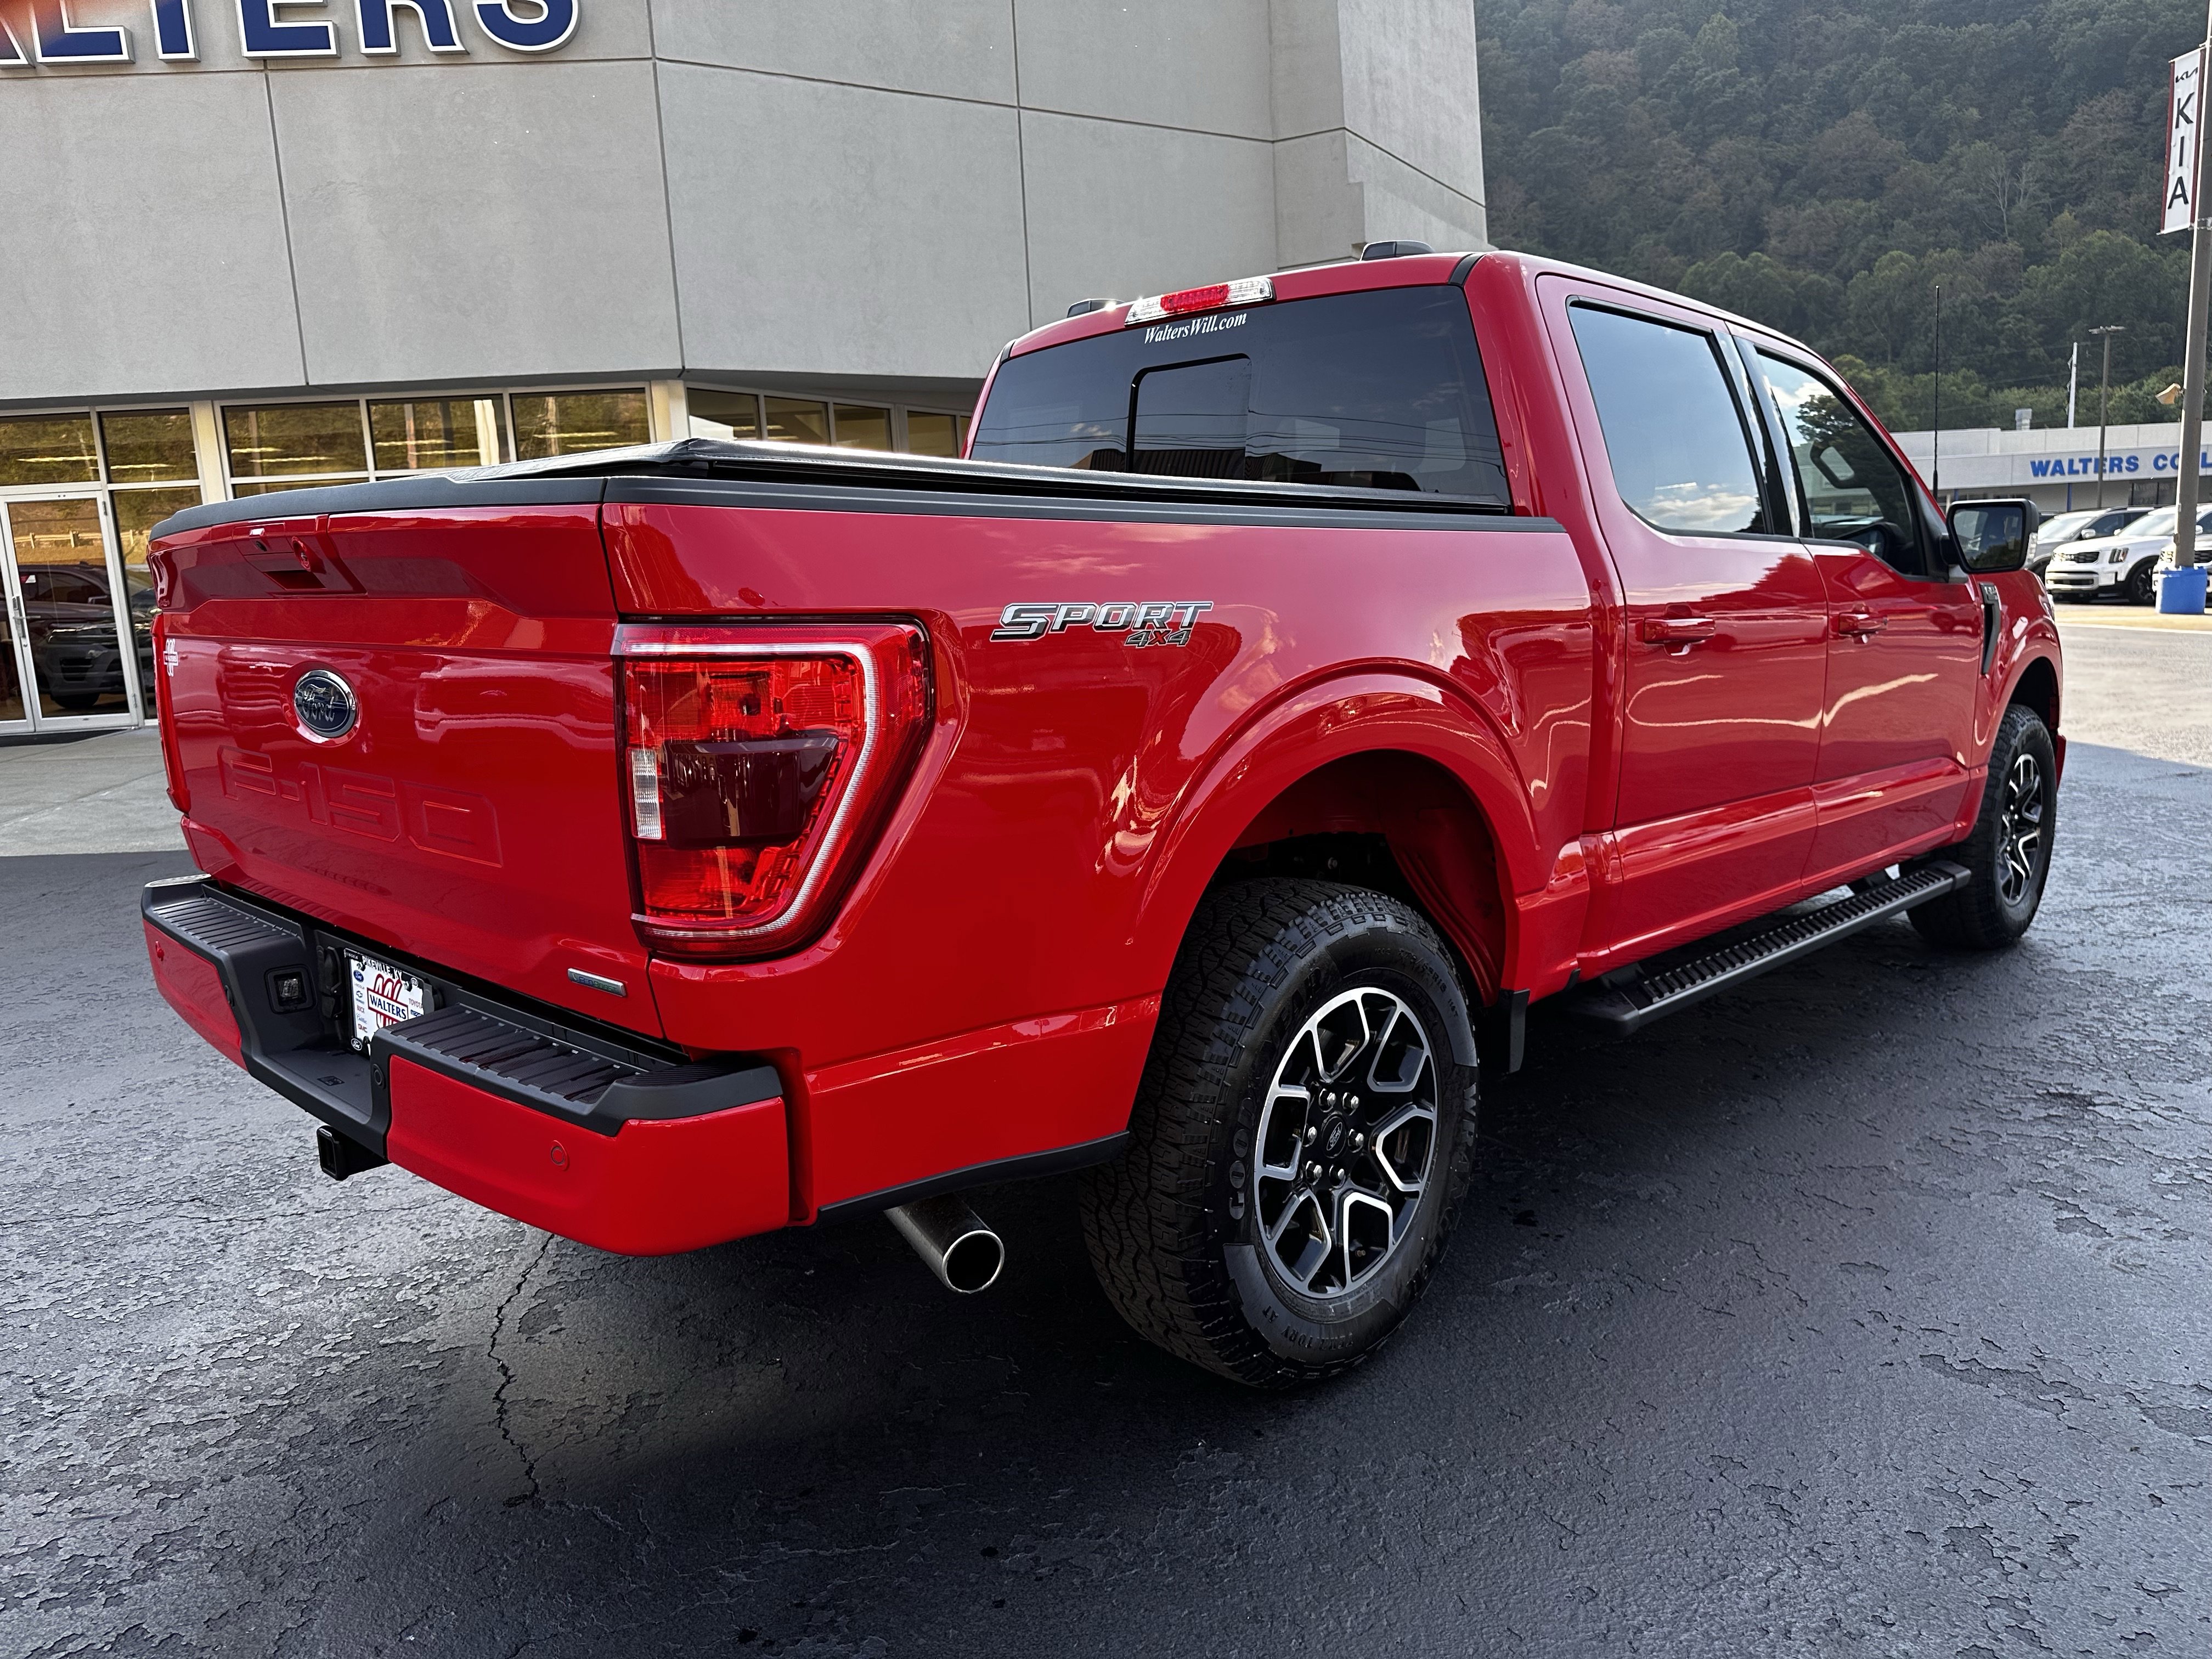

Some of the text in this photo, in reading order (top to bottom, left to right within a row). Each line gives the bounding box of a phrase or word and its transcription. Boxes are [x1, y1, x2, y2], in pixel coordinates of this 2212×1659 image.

[2167, 91, 2195, 210] KIA
[1144, 312, 1247, 345] WaltersWill.com
[2030, 451, 2212, 478] WALTERS COL
[990, 601, 1214, 642] SPORT
[302, 683, 336, 723] Ford
[217, 744, 503, 868] F-150
[393, 968, 403, 980] KY
[369, 994, 407, 1020] WALTERS
[358, 1023, 368, 1034] GMC
